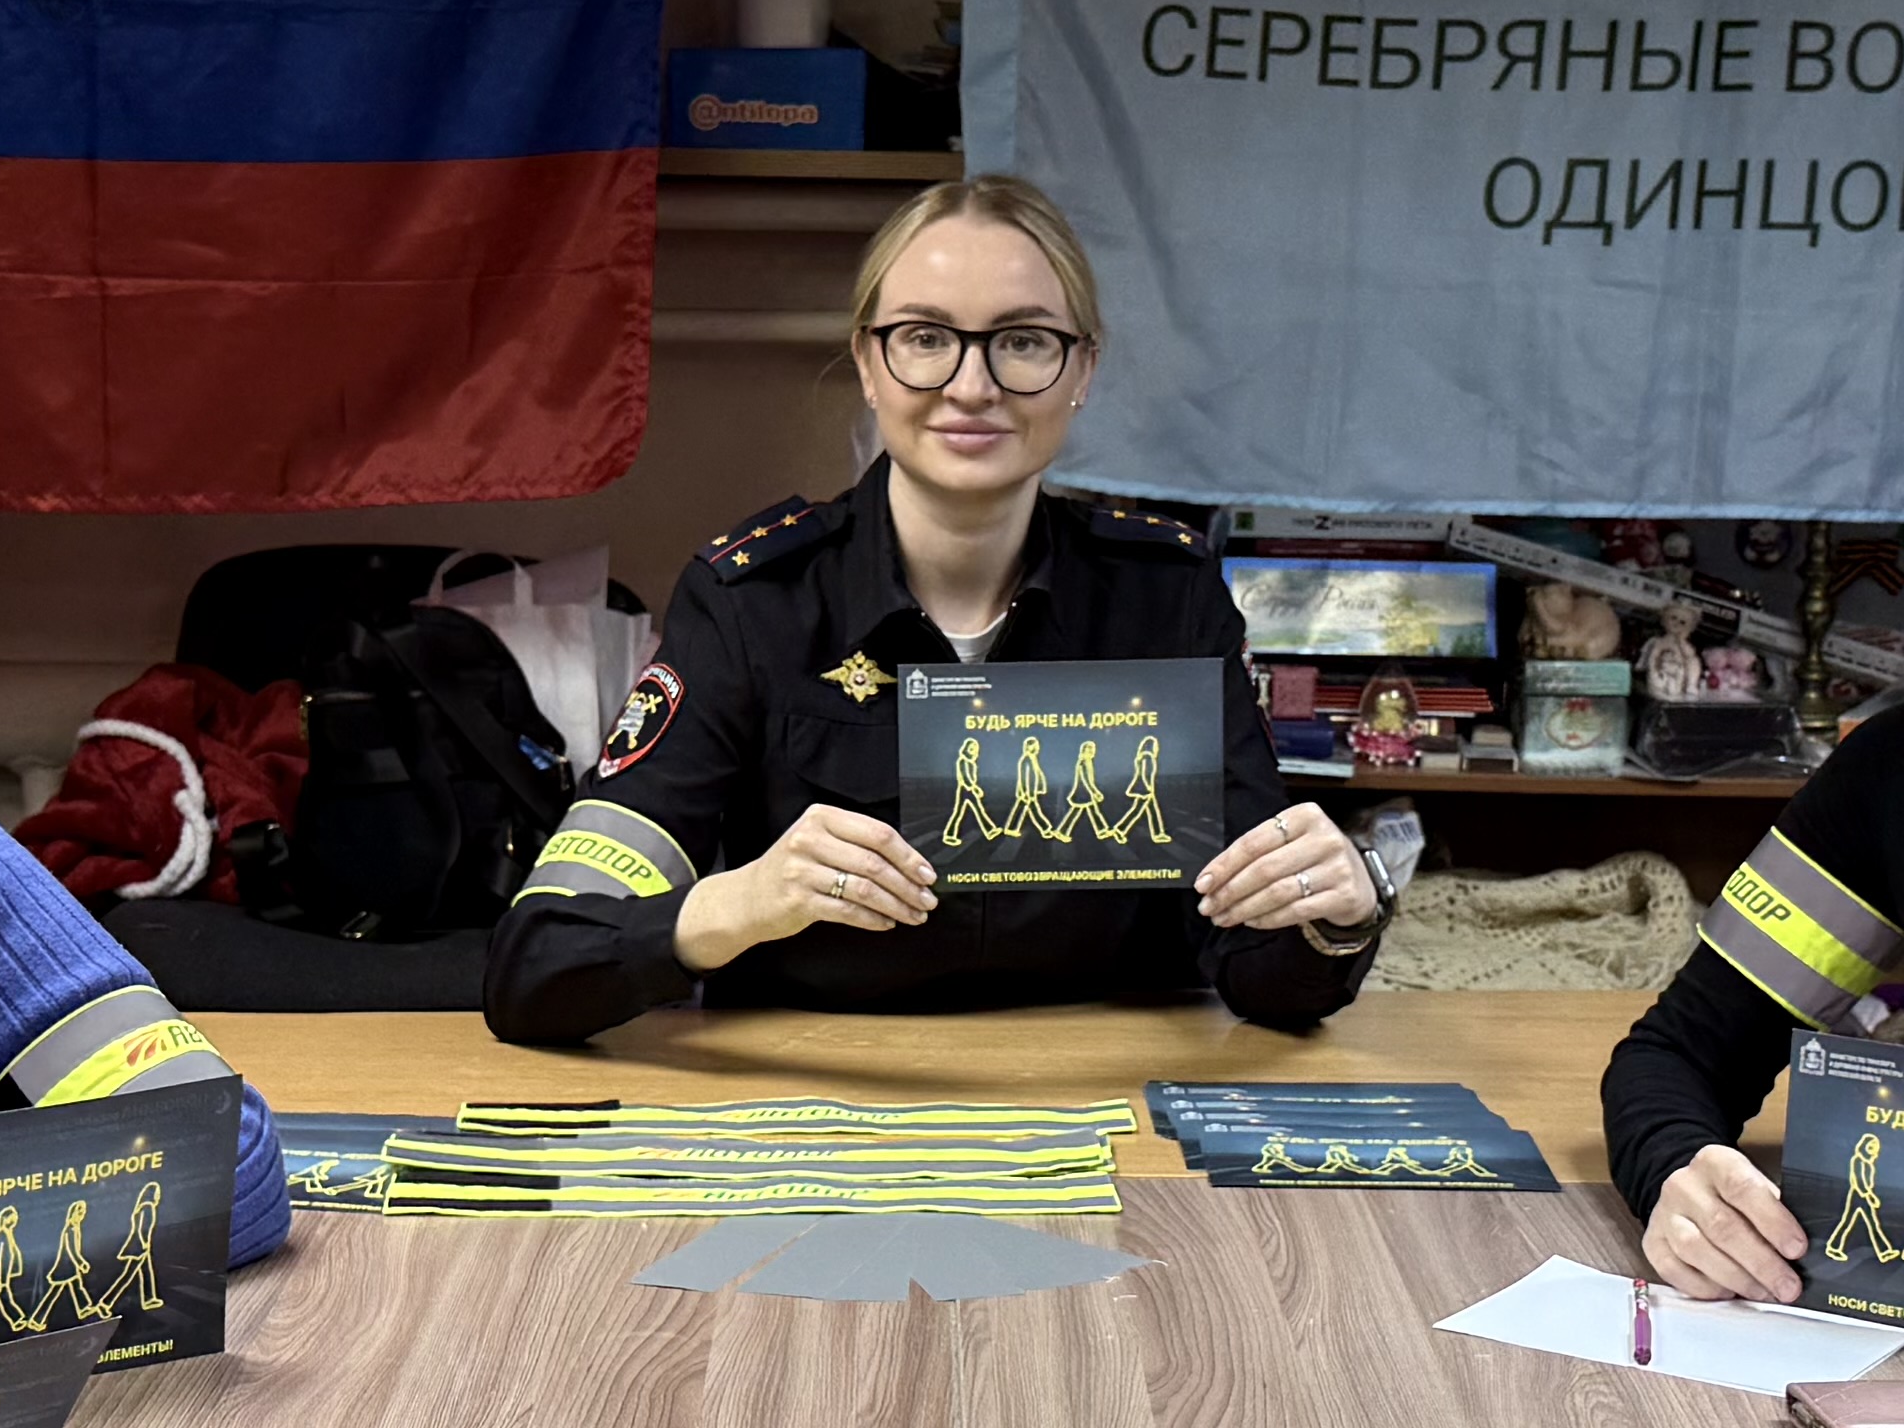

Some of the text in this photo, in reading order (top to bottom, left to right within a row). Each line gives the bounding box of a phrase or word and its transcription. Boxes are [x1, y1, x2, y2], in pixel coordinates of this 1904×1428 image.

[1142, 3, 1760, 94] СЕРЕБРЯНЫЕ
[965, 711, 1158, 730] БУДЬ ЯРЧЕ НА ДОРОГЕ
[48, 1168, 77, 1187] НА
[81, 1151, 164, 1184] ДОРОГЕ
[1828, 1294, 1867, 1312] НОСИ
